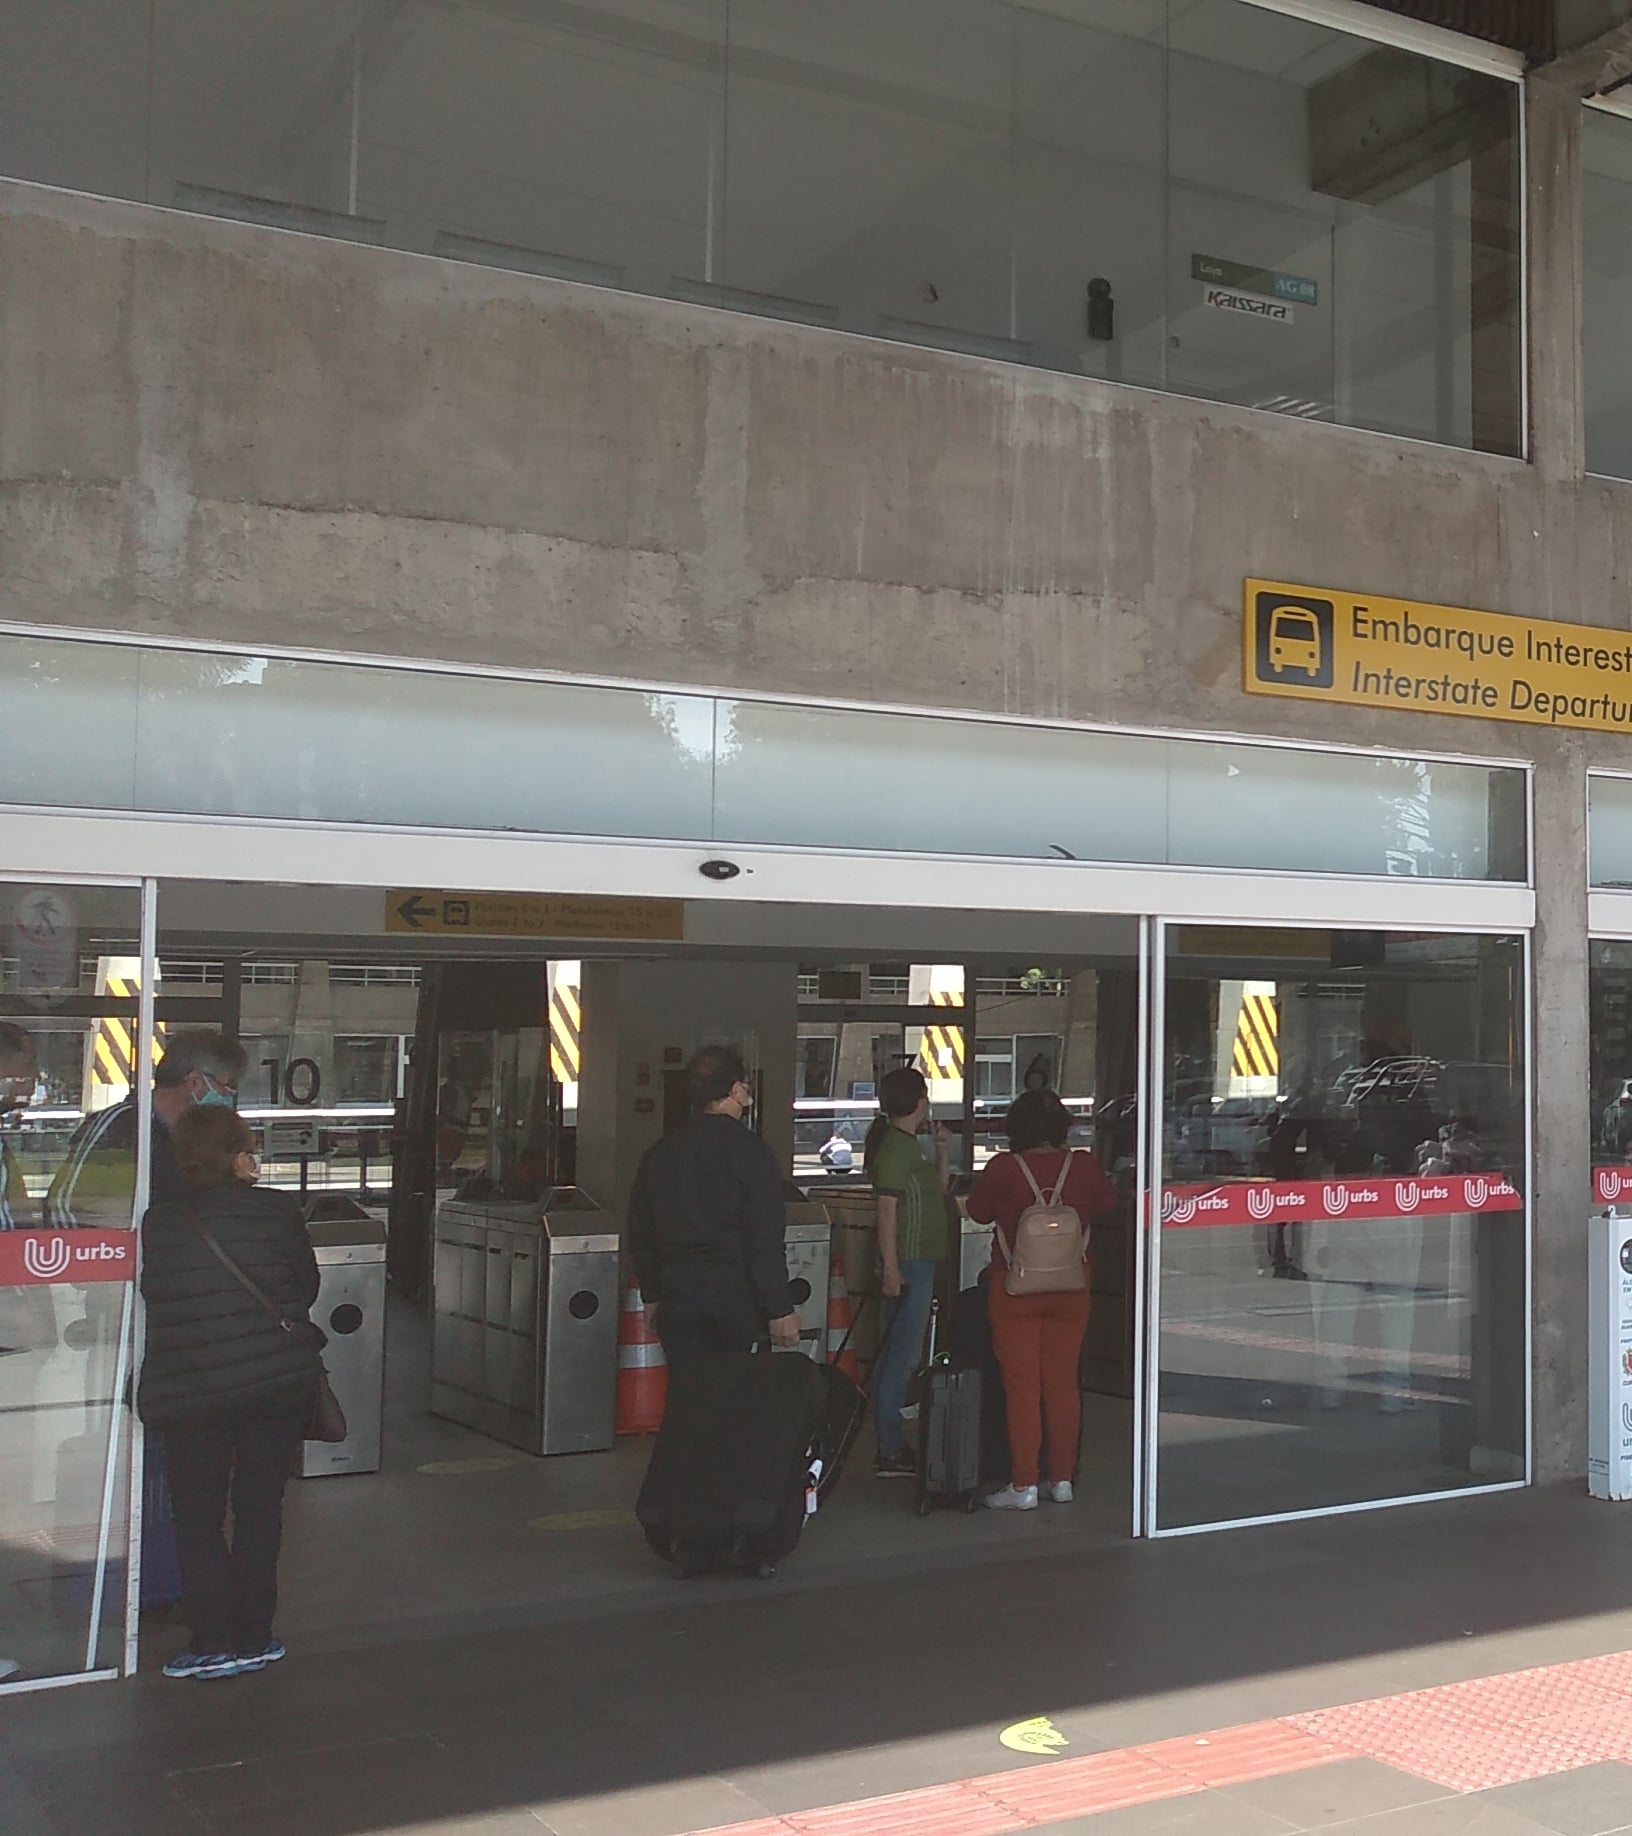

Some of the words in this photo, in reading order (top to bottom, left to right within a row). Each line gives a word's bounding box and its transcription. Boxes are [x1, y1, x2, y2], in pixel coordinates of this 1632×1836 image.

[1208, 290, 1287, 319] Kaissara
[1351, 606, 1515, 661] Embarque
[1352, 661, 1499, 708] Interstate
[261, 1058, 320, 1105] 10
[1199, 1195, 1229, 1210] urbs
[1276, 1193, 1305, 1207] urbs
[1350, 1189, 1379, 1203] urbs
[1421, 1186, 1449, 1200] urbs
[1489, 1182, 1514, 1196] urbs
[76, 1242, 126, 1260] urbs
